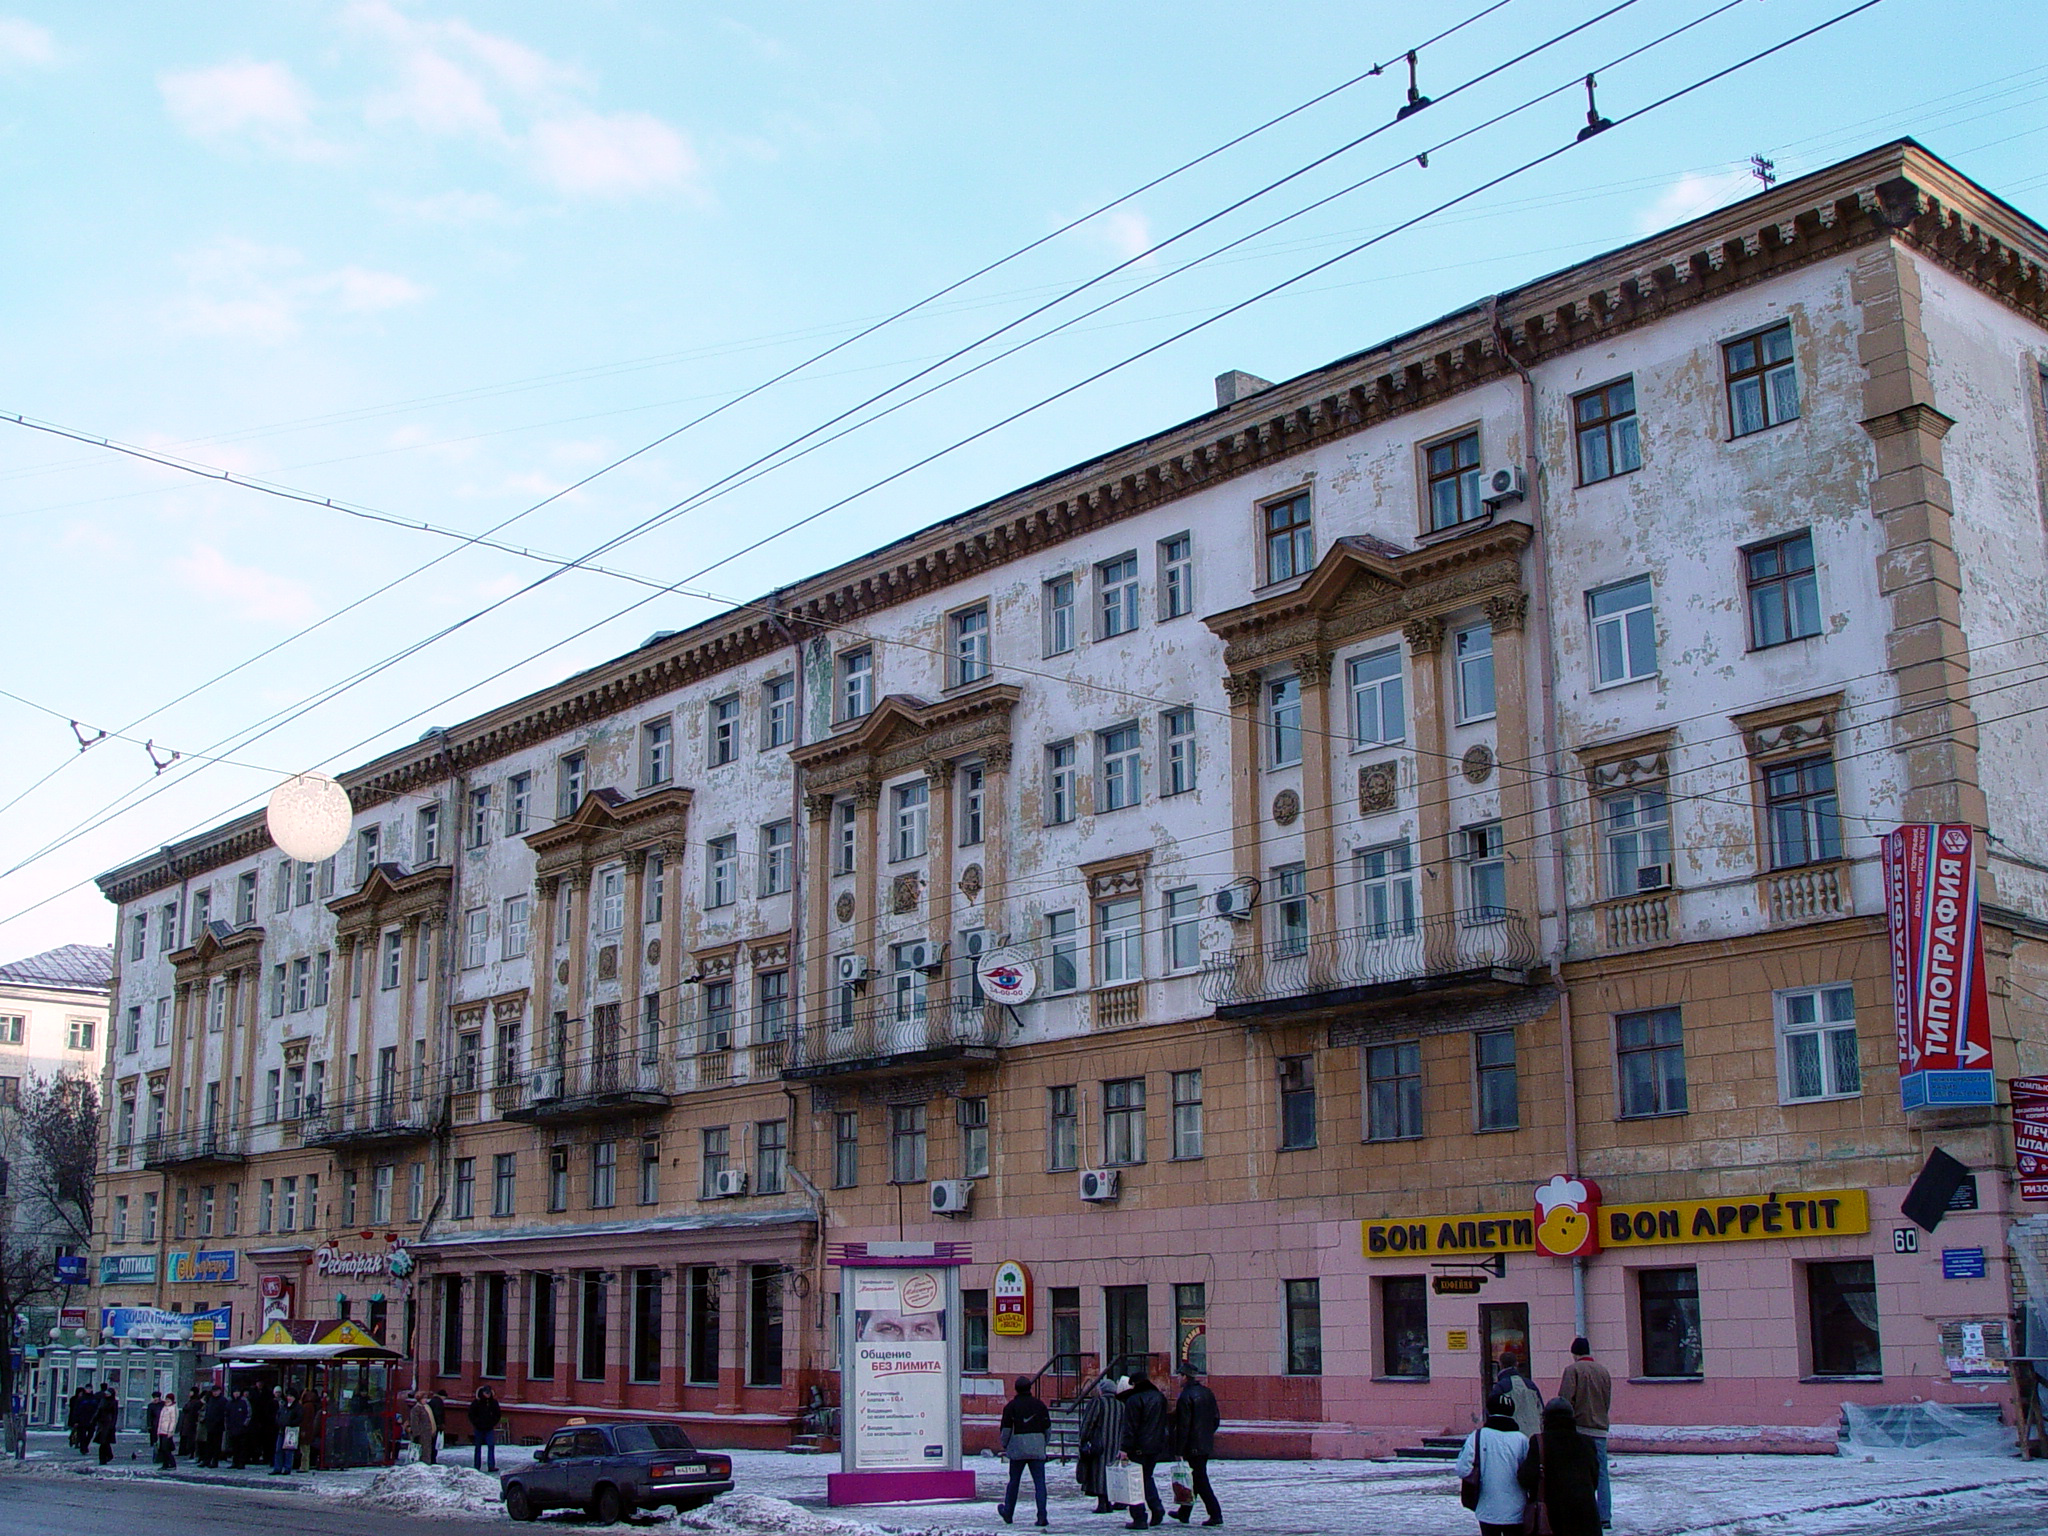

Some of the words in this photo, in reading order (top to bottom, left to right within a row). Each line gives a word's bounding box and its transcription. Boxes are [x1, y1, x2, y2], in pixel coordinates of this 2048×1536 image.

[1893, 863, 1908, 1063] ТИПОГРАФИЯ
[1924, 858, 1962, 1056] ТИПОГРАФИЯ
[2023, 1125, 2048, 1139] ПЕЧ
[1610, 1209, 1680, 1241] BON
[1692, 1192, 1840, 1236] APPÉTIT
[1368, 1224, 1427, 1253] БОН
[1437, 1218, 1533, 1250] АПЕТИ
[1894, 1230, 1917, 1252] 60
[119, 1257, 152, 1274] ОПТИКА
[317, 1247, 384, 1280] Ресторан
[1440, 1279, 1474, 1290] КОФЕЙНЯ
[860, 1349, 912, 1360] Общение
[1182, 1326, 1201, 1360] МАГАЗИН
[871, 1361, 893, 1371] БЕЗ
[894, 1361, 942, 1371] ЛИМИТА
